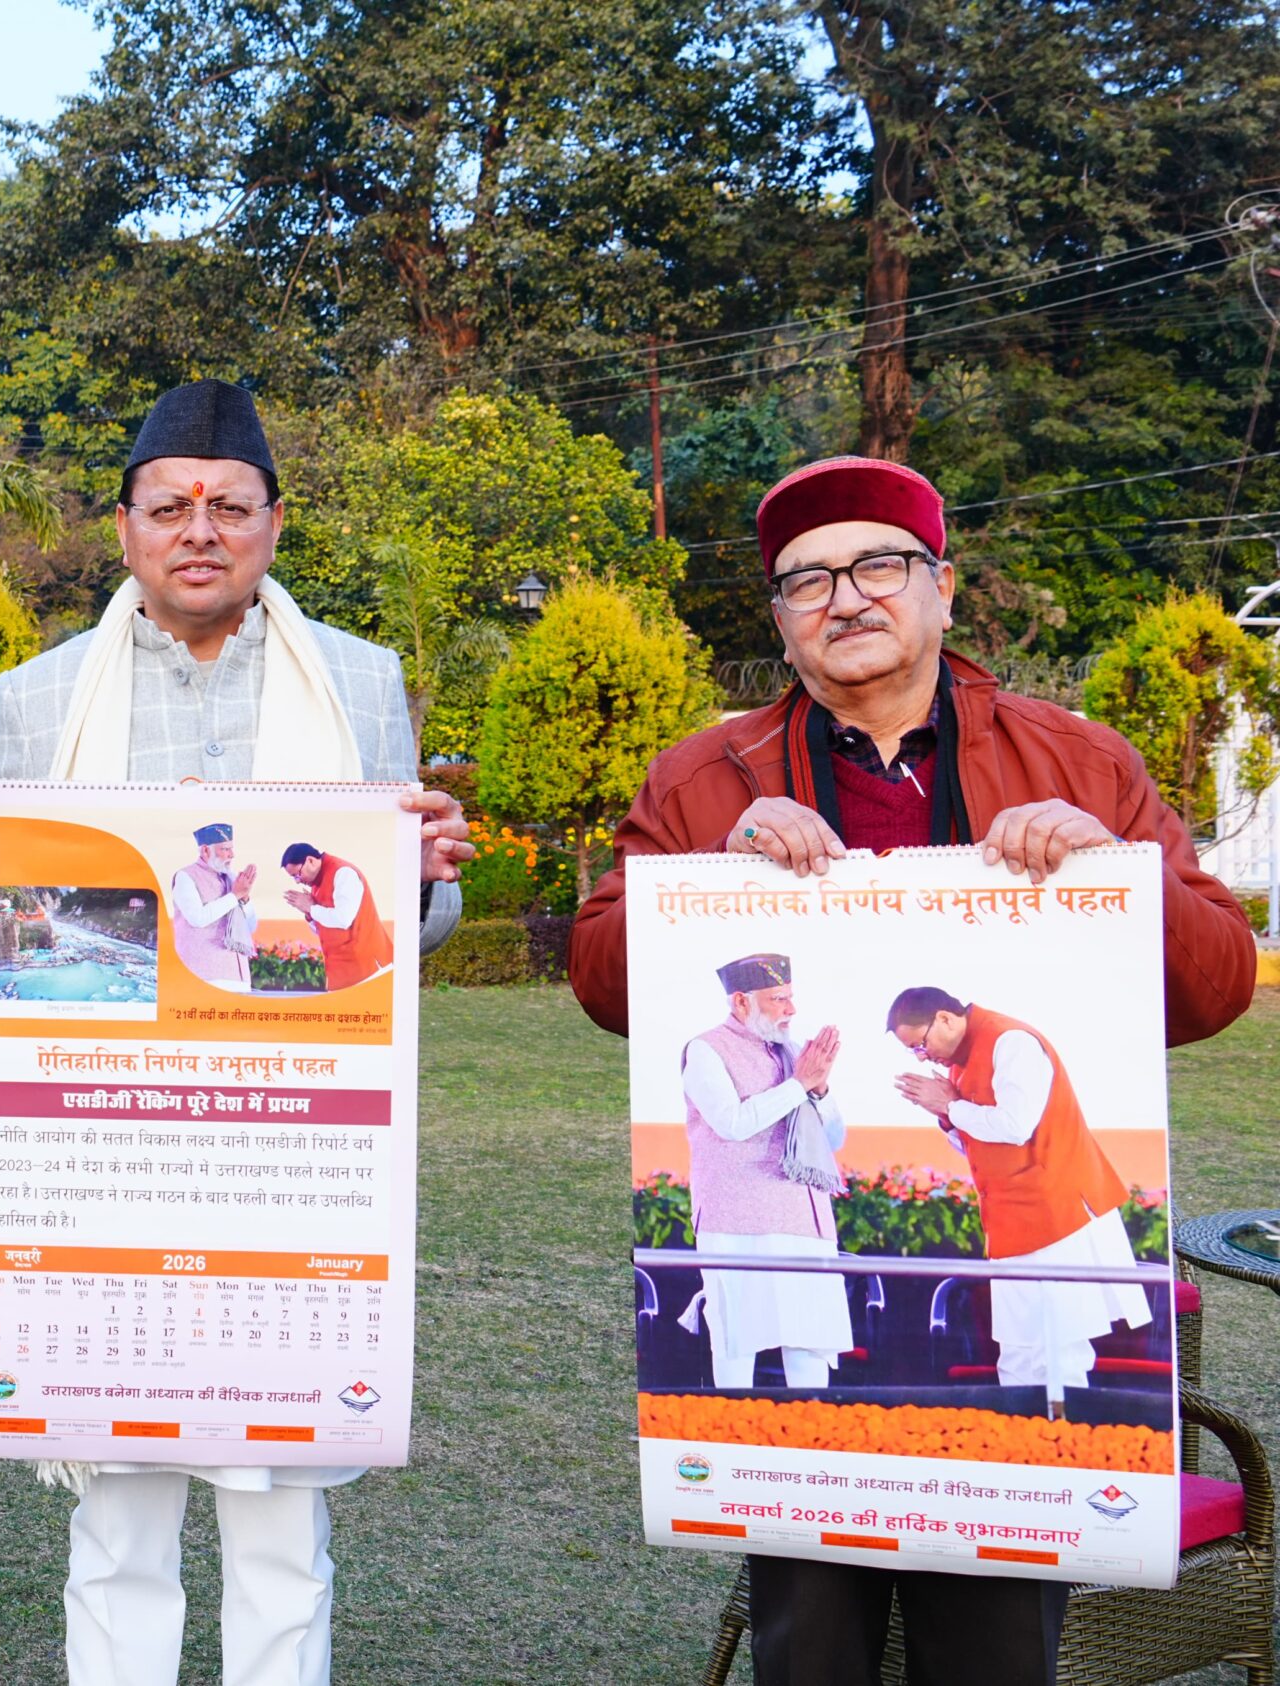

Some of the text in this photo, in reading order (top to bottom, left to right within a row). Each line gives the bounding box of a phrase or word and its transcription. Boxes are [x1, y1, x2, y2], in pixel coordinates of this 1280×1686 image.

[656, 878, 810, 924] ऐतिहासिक
[819, 880, 907, 915] निर्णय
[1056, 888, 1131, 916] पहल
[200, 1008, 216, 1020] सदी
[218, 1012, 228, 1020] का
[232, 1009, 256, 1020] तीसरा
[258, 1012, 280, 1021] दशक
[282, 1013, 322, 1022] उत्तराखण्ड
[324, 1014, 335, 1022] का
[338, 1014, 360, 1023] दशक
[38, 1046, 338, 1081] ऐतिहासिक निर्णय अभूतपूर्व पहल
[62, 1090, 311, 1115] एसडीजी रैंकिंग पूरे देश में प्रथम
[0, 1126, 373, 1151] नीति आयोग की सतत विकास लक्ष्य यानी एसडीजी रिपोर्ट वर्ष
[66, 1156, 76, 1172] में
[82, 1156, 104, 1174] देश
[108, 1157, 121, 1173] के
[126, 1158, 152, 1174] सभी
[158, 1159, 193, 1175] राज्यों
[199, 1159, 209, 1176] में
[215, 1164, 280, 1177] उत्तराखण्ड
[284, 1162, 312, 1178] पहले
[319, 1167, 350, 1179] स्थान
[355, 1168, 374, 1180] पर
[40, 1188, 104, 1200] उत्तराखण्ड
[108, 1185, 117, 1201] ने
[122, 1190, 152, 1202] राज्य
[156, 1191, 186, 1203] गठन
[190, 1187, 202, 1203] के
[206, 1192, 229, 1204] बाद
[234, 1188, 266, 1205] पहली
[271, 1194, 294, 1206] बार
[298, 1194, 317, 1206] यह
[320, 1191, 372, 1208] उपलब्धि
[41, 1211, 57, 1227] की
[6, 1249, 42, 1264] जनवरी
[163, 1254, 206, 1270] 2026
[307, 1256, 364, 1272] January
[14, 1276, 35, 1284] Mon
[46, 1277, 62, 1285] Tue
[72, 1278, 94, 1286] Wed
[106, 1278, 123, 1287] Thu
[162, 1280, 177, 1288] Sat
[190, 1281, 208, 1289] Sun
[217, 1282, 238, 1290] Mon
[249, 1282, 265, 1290] Tue
[275, 1283, 296, 1291] Wed
[308, 1284, 326, 1292] Thu
[338, 1285, 350, 1293] Fri
[367, 1286, 381, 1294] Sat
[17, 1344, 29, 1353] 26
[46, 1345, 58, 1354] 27
[76, 1346, 88, 1355] 28
[107, 1347, 118, 1356] 29
[134, 1348, 145, 1356] 30
[163, 1349, 173, 1357] 31
[42, 1384, 321, 1403] उत्तराखण्ड बनेगा अध्यात्म की वैश्विक राजधानी
[732, 1469, 1072, 1504] उत्तराखण्ड बनेगा अध्यात्म की वैश्विक राजधानी
[720, 1503, 782, 1518] नववर्ष
[791, 1508, 844, 1524] 2026
[852, 1510, 878, 1526] की
[885, 1513, 948, 1532] हार्दिक
[955, 1522, 1081, 1547] शुभकामनाएं
